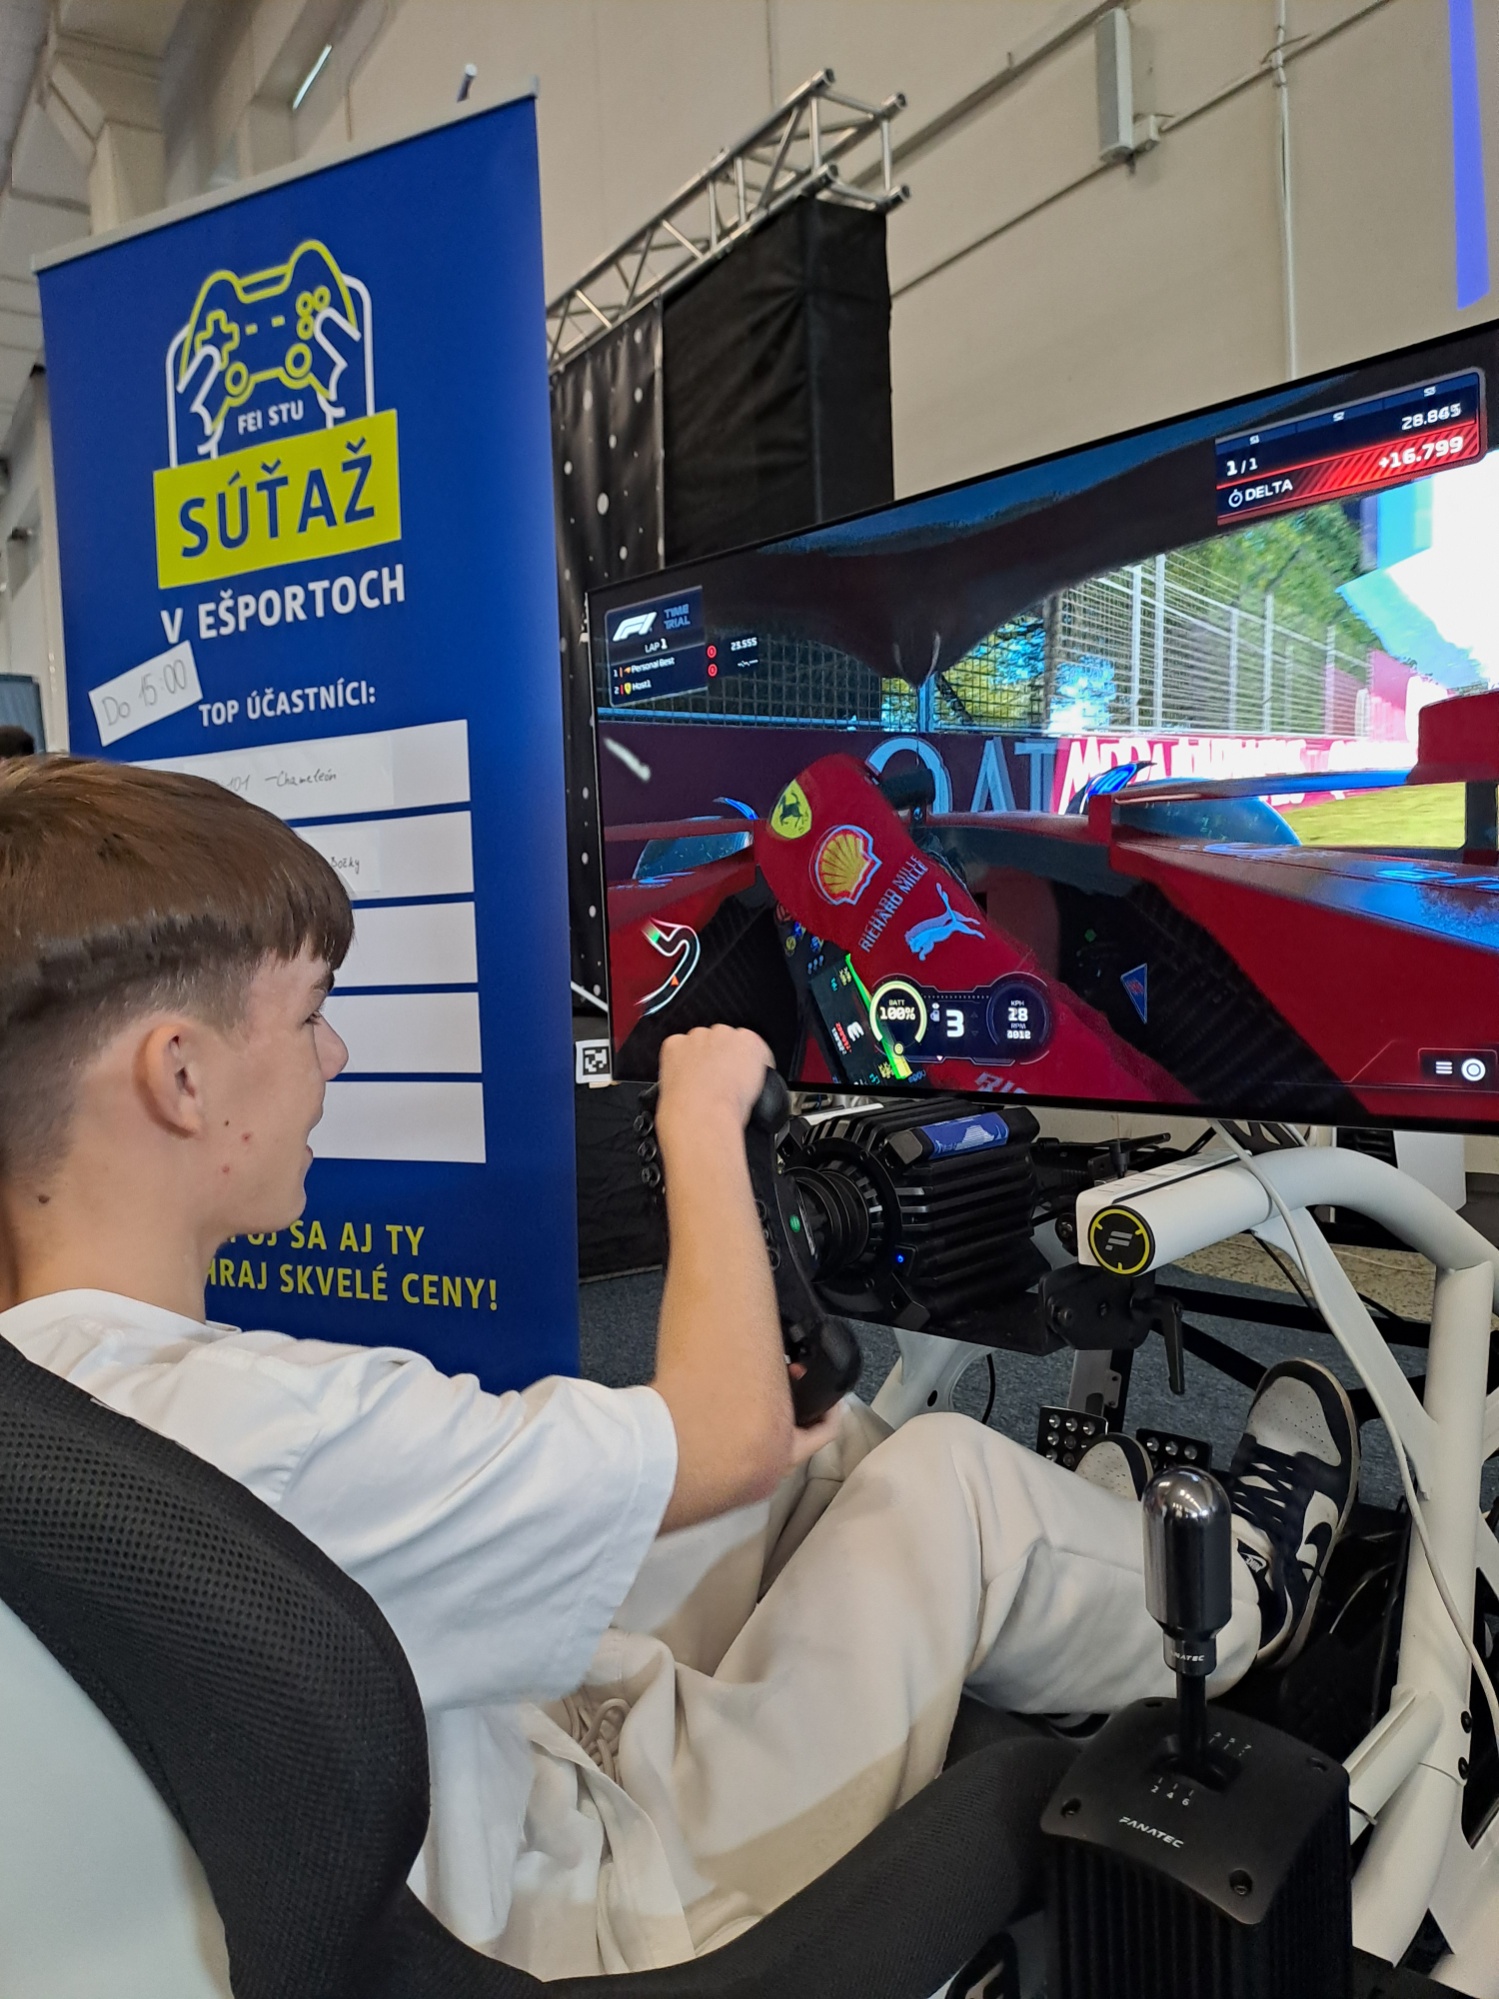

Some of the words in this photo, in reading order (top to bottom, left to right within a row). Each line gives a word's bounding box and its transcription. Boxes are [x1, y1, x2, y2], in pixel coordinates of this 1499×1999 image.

[237, 410, 263, 434] FEI
[269, 400, 304, 426] STU
[1379, 436, 1464, 470] +16.799
[179, 436, 375, 559] SÚŤAŽ
[1245, 479, 1293, 502] DELTA
[160, 607, 183, 644] V
[198, 564, 405, 639] EŠPORTOCH
[664, 603, 689, 618] TIME
[664, 616, 691, 630] TRIAL
[644, 642, 660, 654] LAP
[660, 637, 668, 650] 1
[631, 660, 659, 674] Personal
[659, 656, 676, 667] Best
[101, 695, 131, 727] Do
[199, 700, 239, 727] TOP
[247, 678, 376, 720] ÚČASTNÍCI:
[858, 888, 904, 953] RICHARD
[892, 855, 928, 895] MILLE
[880, 1007, 916, 1021] 100%
[946, 1009, 965, 1038] 3
[290, 1220, 327, 1250] SA
[339, 1222, 372, 1253] AJ
[385, 1224, 425, 1256] TY
[279, 1263, 388, 1301] SKVELÉ
[402, 1273, 498, 1311] CENY!
[1151, 1785, 1160, 1794] 2
[1166, 1791, 1174, 1799] 4
[1182, 1798, 1190, 1807] 6
[1118, 1816, 1185, 1849] FANATEC
